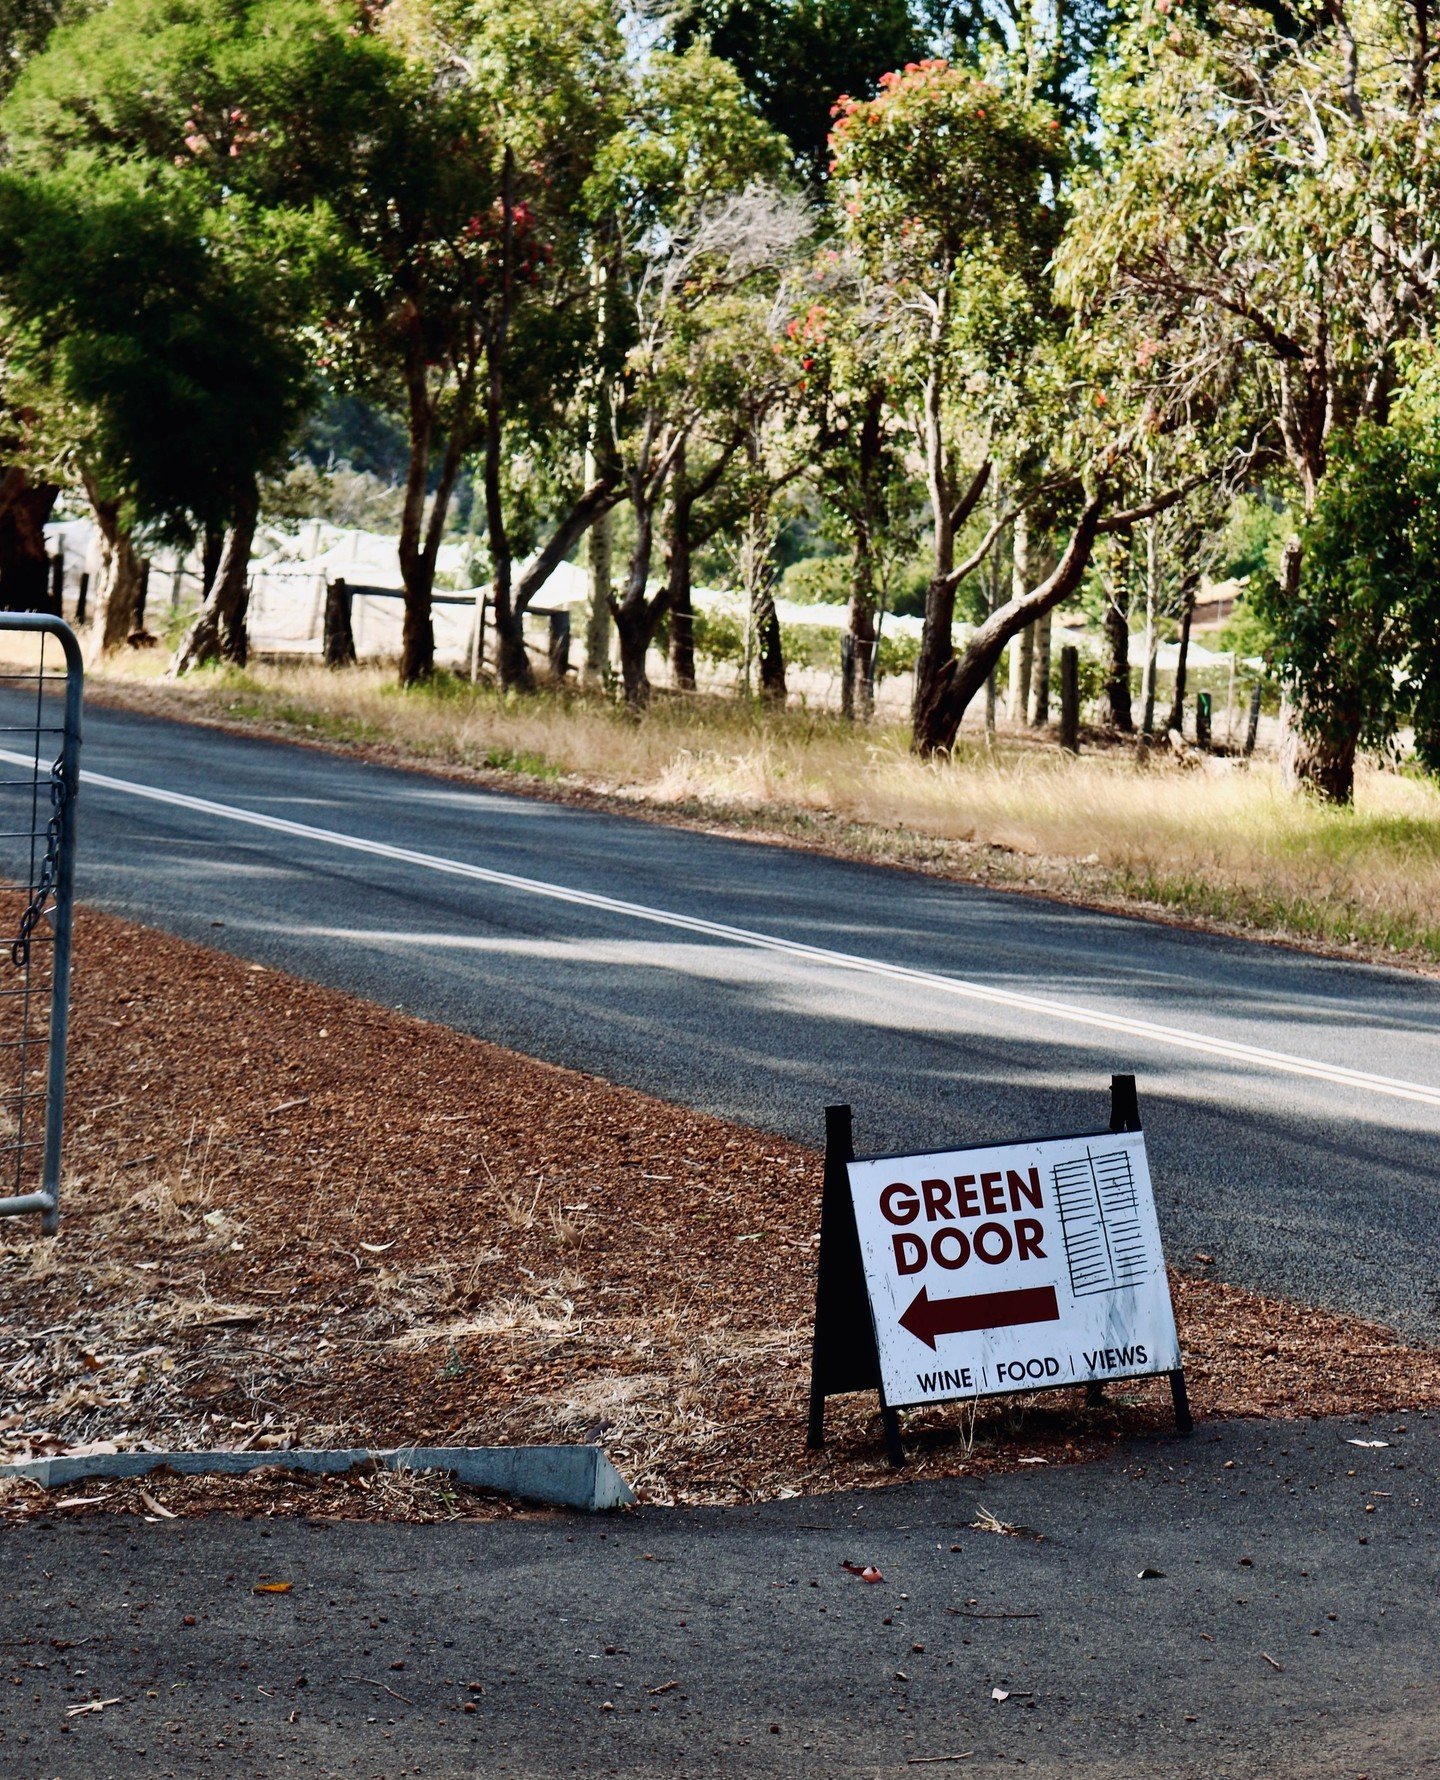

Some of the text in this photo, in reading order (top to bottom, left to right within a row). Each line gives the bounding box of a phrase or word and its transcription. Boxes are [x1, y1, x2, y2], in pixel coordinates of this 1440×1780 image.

[879, 1167, 1044, 1226] GREEN
[891, 1218, 1048, 1276] DOOR
[917, 1345, 1148, 1393] WINE FOOD VIEWS
